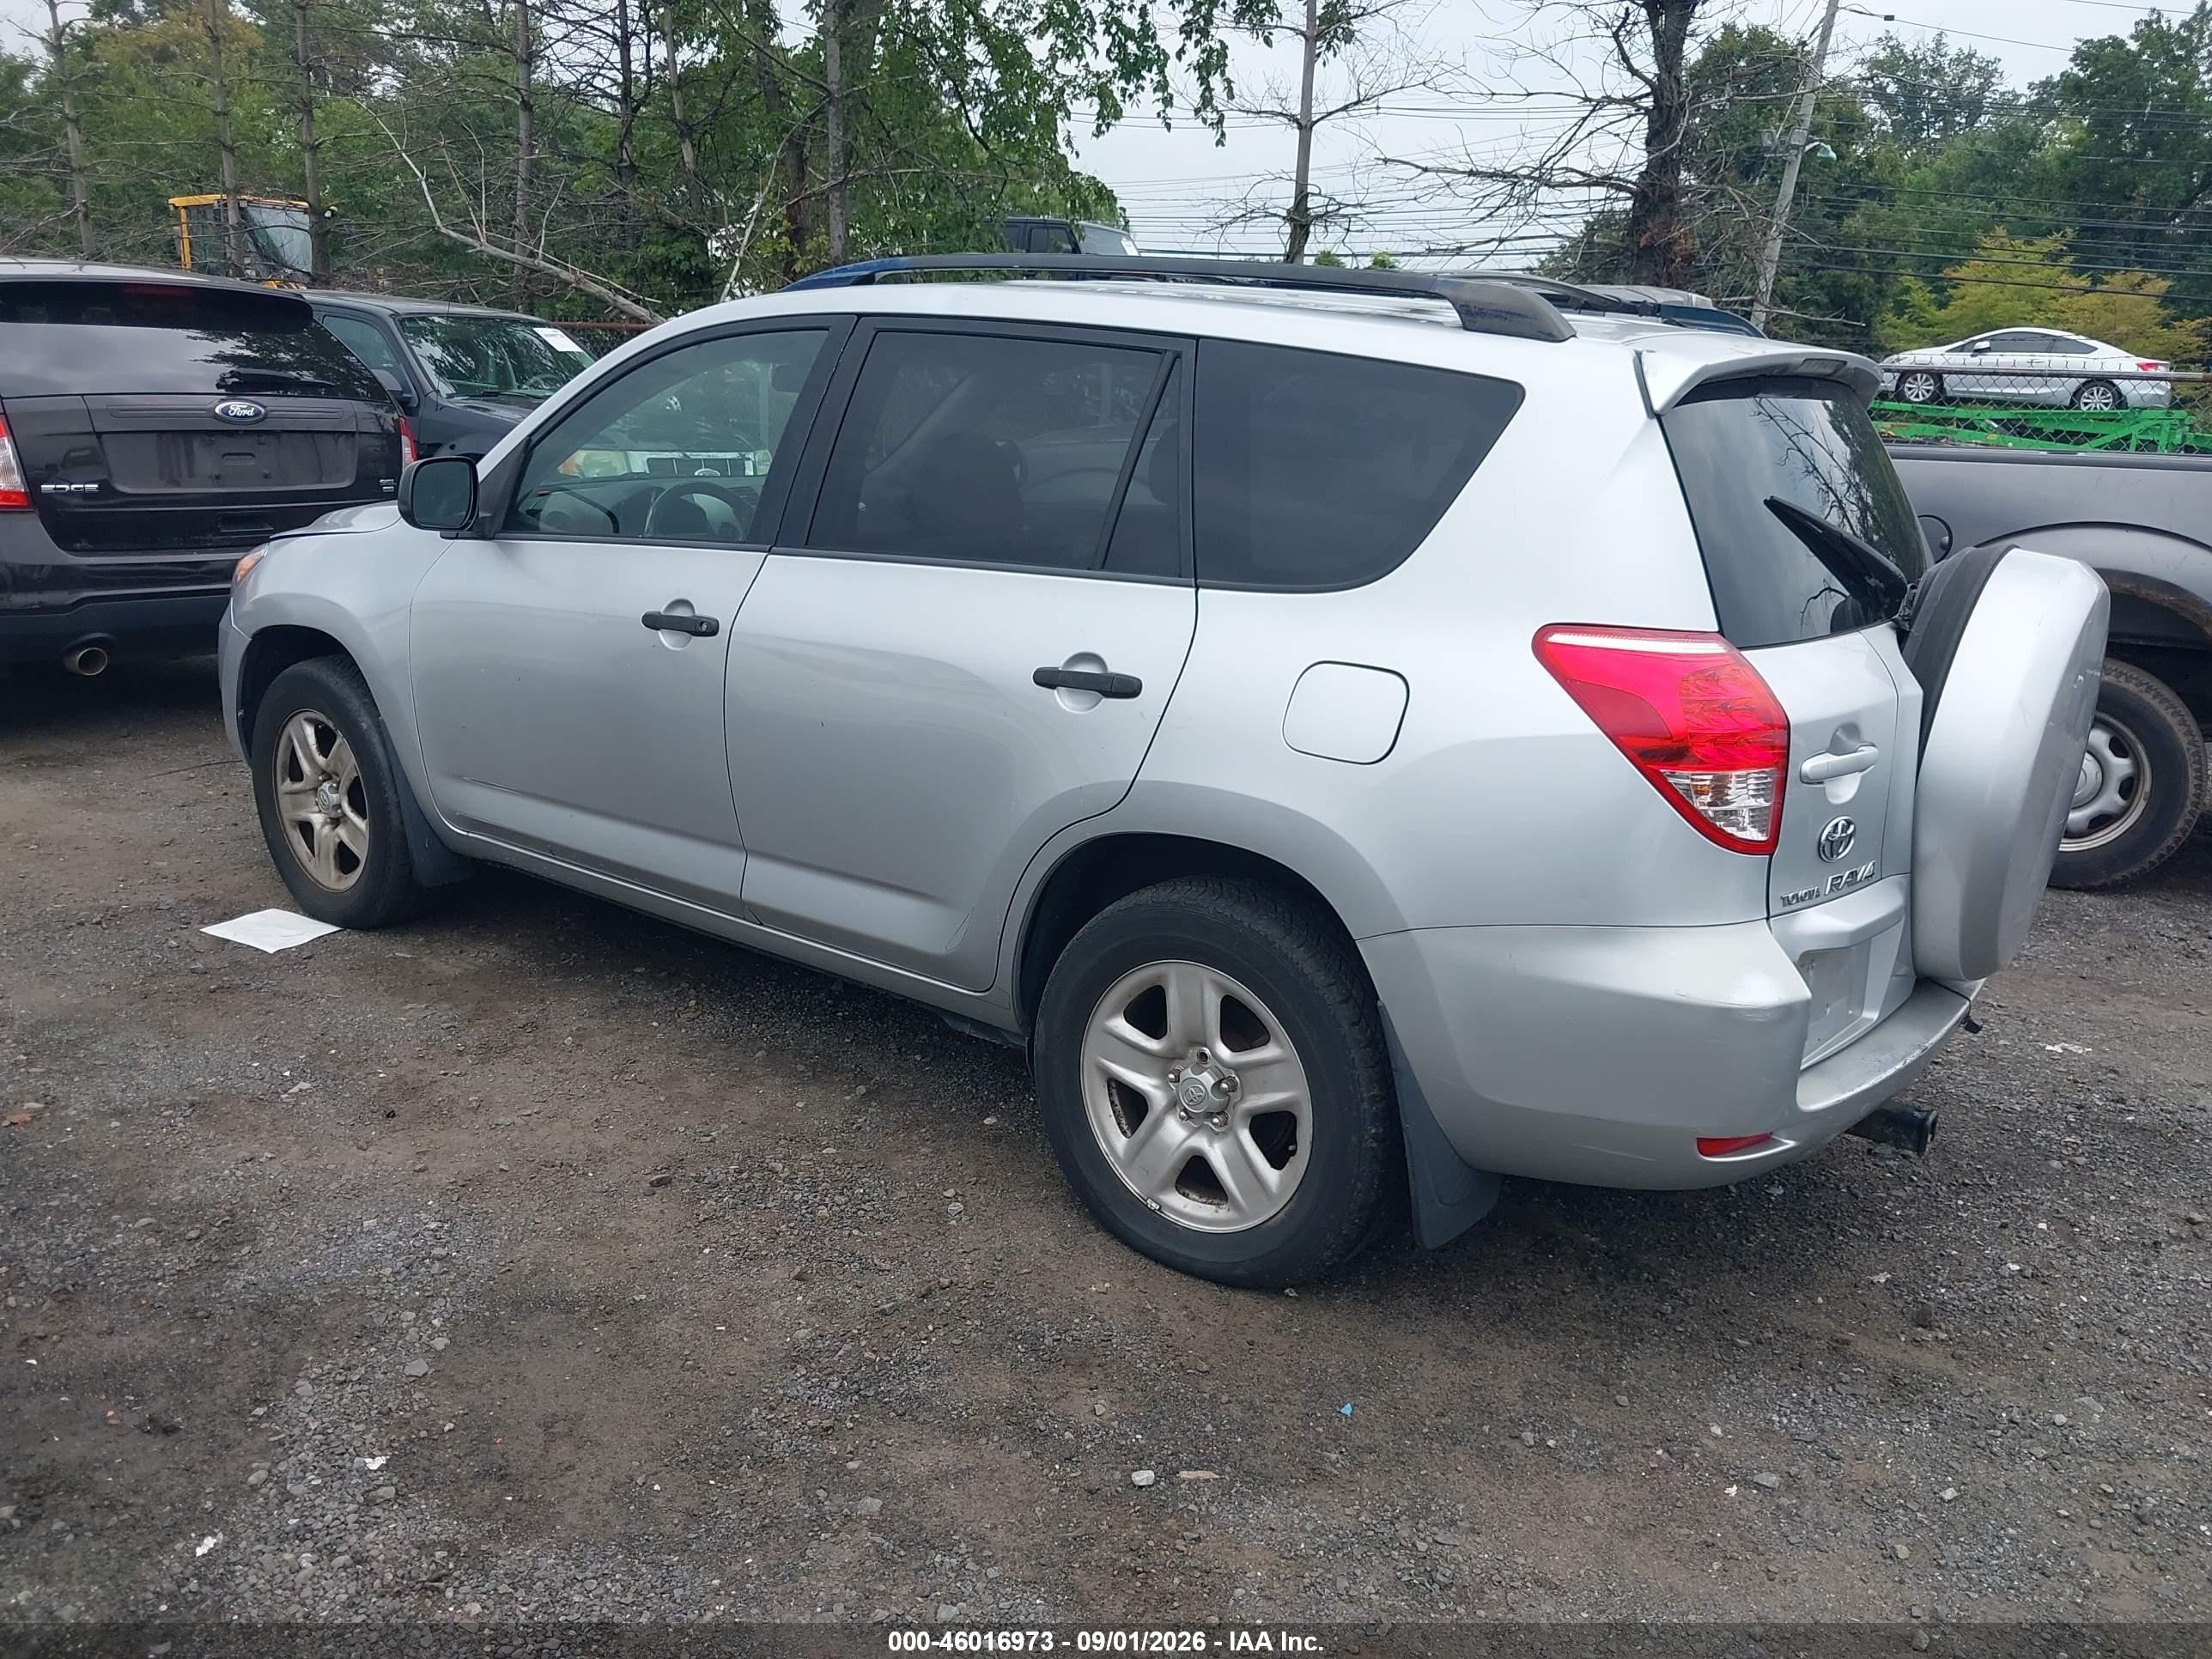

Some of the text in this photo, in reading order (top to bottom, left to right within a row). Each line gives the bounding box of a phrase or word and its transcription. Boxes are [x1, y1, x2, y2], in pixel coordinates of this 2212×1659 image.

[228, 404, 255, 416] Ford
[40, 483, 100, 494] EDGE
[1780, 860, 1876, 908] TOYOTA RAV4
